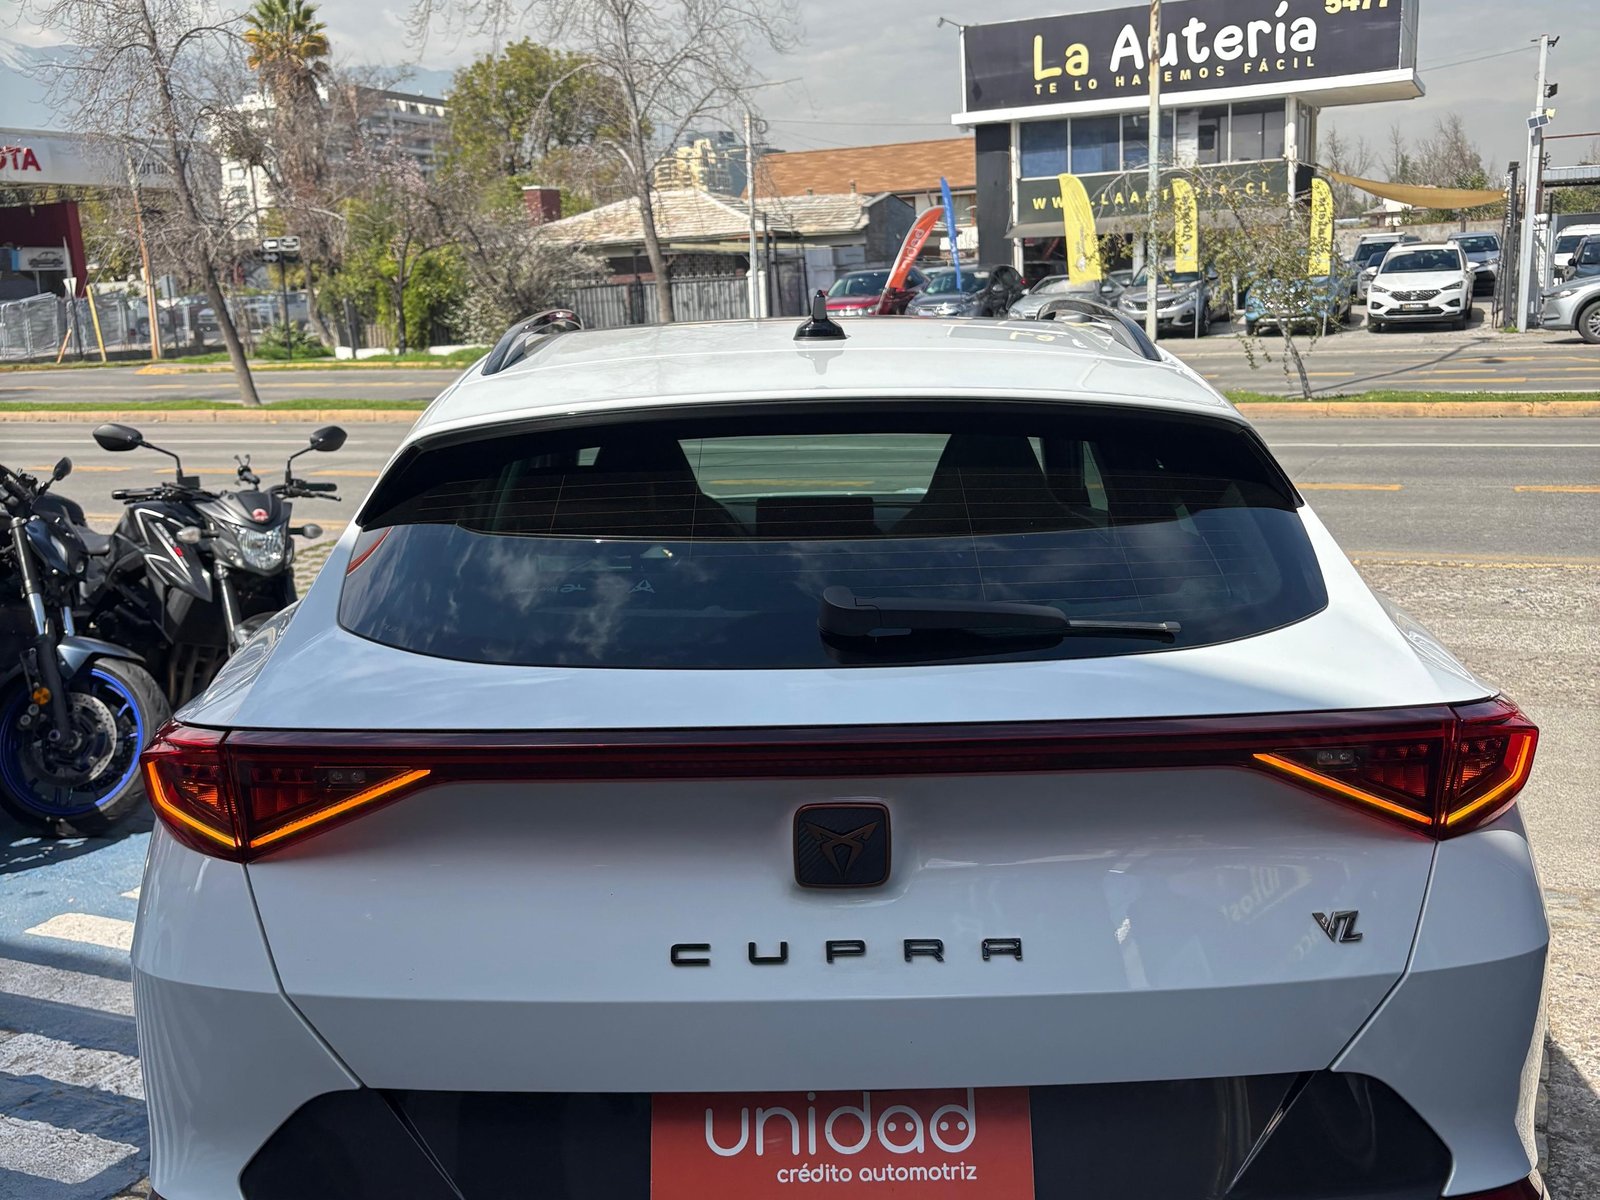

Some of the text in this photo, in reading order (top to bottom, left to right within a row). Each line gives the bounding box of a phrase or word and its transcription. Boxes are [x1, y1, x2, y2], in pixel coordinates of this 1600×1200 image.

[1033, 0, 1317, 81] La Autería
[1034, 56, 1315, 95] TE LO HAEMOS FÁCIL
[0, 145, 42, 171] TA
[1311, 910, 1363, 944] VZ
[669, 937, 1023, 967] CUPRA
[705, 1087, 976, 1157] unidad
[777, 1161, 978, 1184] crédito automotriz
